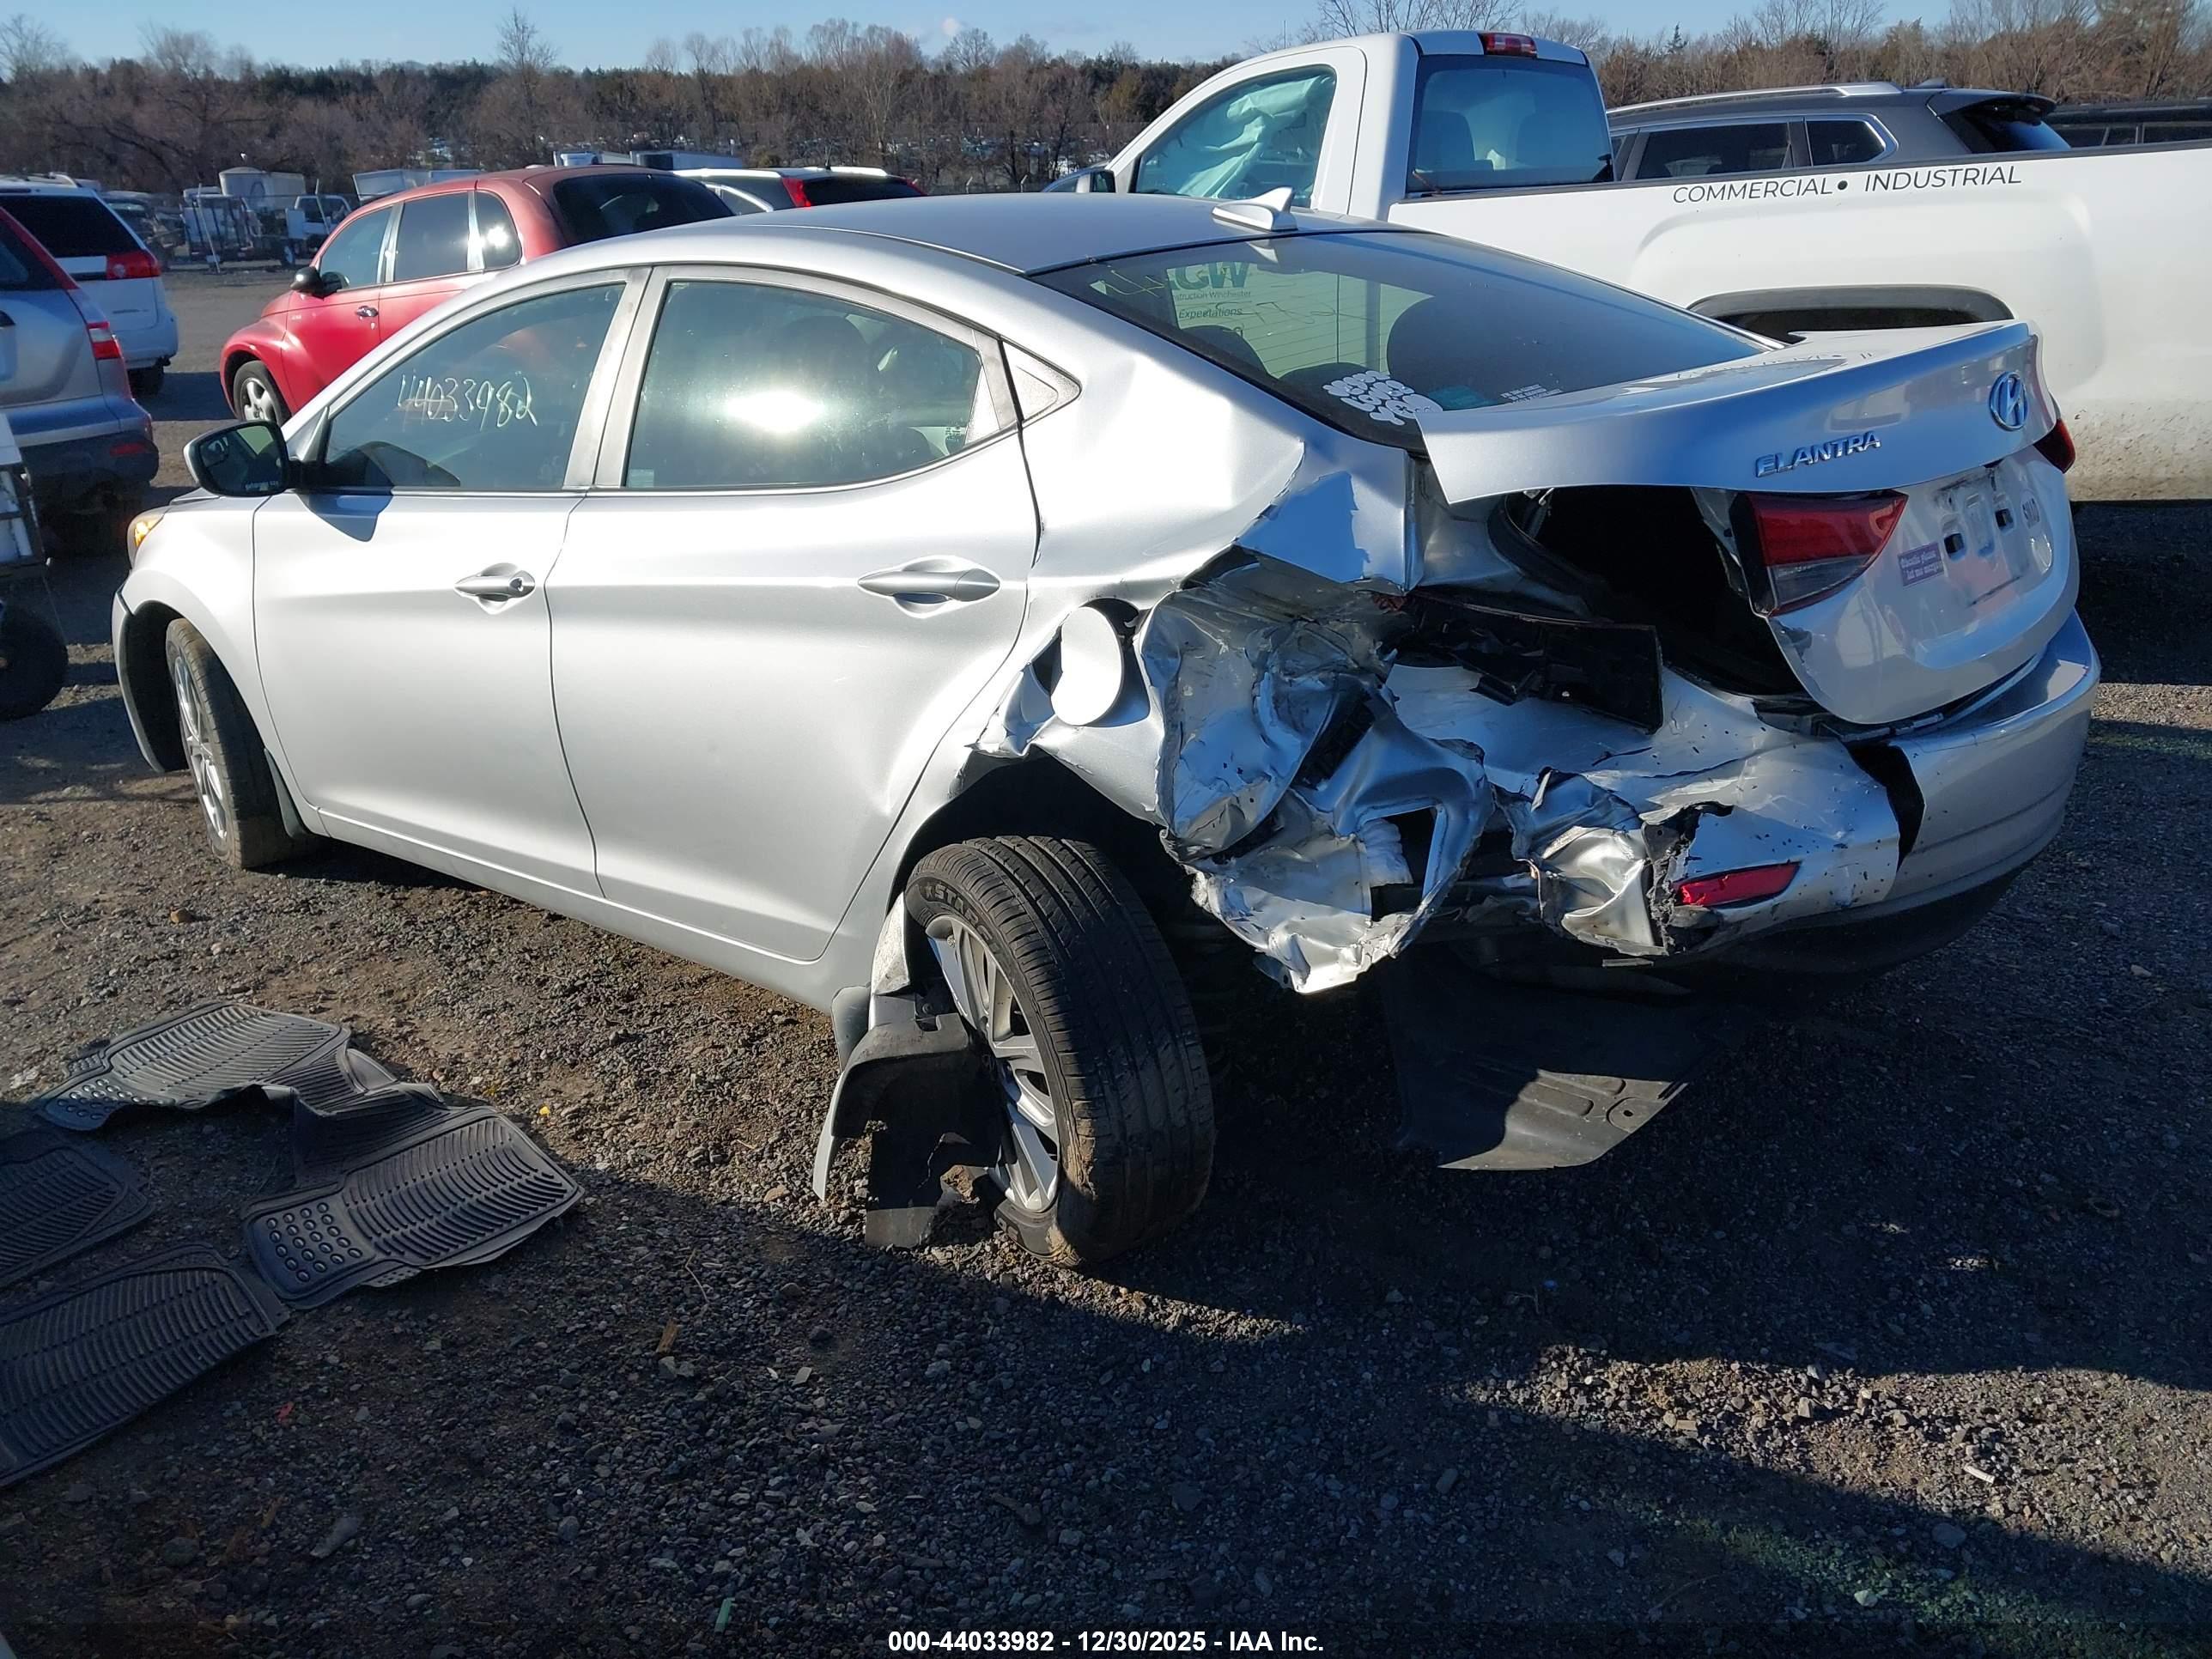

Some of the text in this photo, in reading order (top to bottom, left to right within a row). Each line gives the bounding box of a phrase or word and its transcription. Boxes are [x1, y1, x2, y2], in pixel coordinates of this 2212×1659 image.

[1673, 165, 2021, 204] COMMERCIAL INDUSTRIAL
[1179, 307, 1243, 320] Expectations
[398, 374, 538, 432] 44033982
[1755, 430, 1882, 477] ELANTRA
